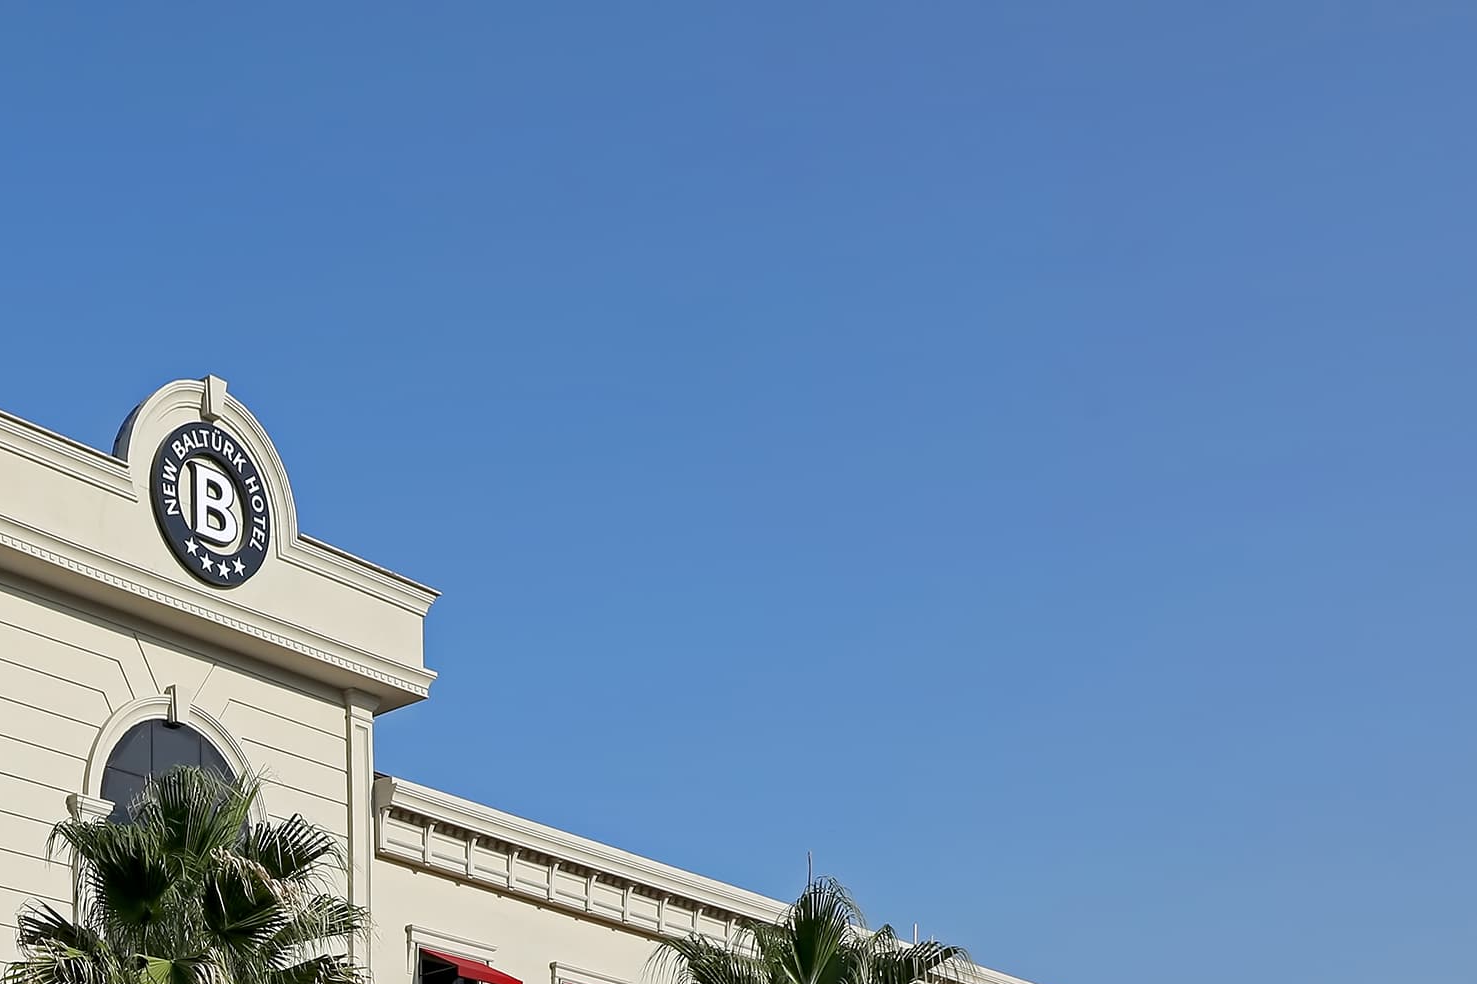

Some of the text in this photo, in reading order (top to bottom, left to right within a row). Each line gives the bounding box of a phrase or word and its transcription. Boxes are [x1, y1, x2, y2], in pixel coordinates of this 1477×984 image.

[162, 428, 266, 551] NEW BALTÜRK HOTEL
[192, 462, 238, 545] B
